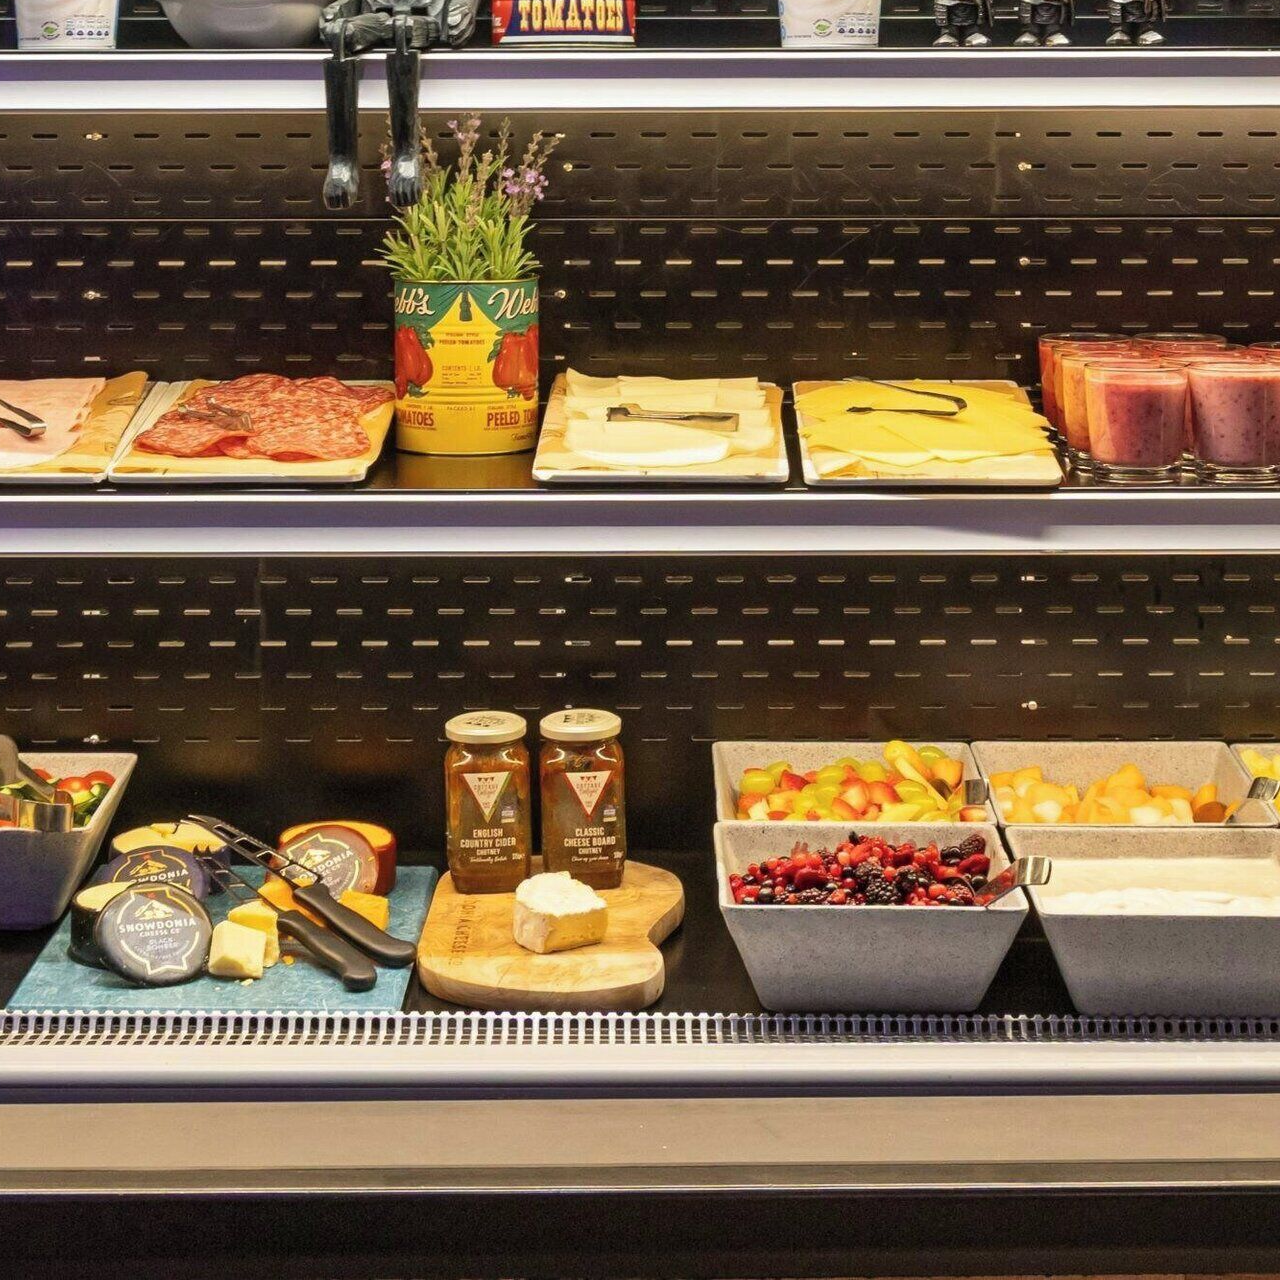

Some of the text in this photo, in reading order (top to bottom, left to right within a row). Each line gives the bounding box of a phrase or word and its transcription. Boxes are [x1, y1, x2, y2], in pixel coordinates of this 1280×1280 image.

[395, 287, 436, 315] ebb's
[397, 408, 435, 427] MATOES
[486, 411, 520, 427] PEELED
[473, 828, 503, 838] ENGLISH
[575, 827, 605, 837] CLASSIC
[460, 837, 516, 848] COUNTRY CIDER
[564, 836, 616, 847] CHEESE BOARD
[476, 848, 500, 856] CHUTNEY
[578, 847, 602, 855] CHUTNEY
[130, 868, 189, 884] OWDONIA
[118, 917, 197, 934] SNOWDONIA
[139, 929, 168, 938] CHEESE
